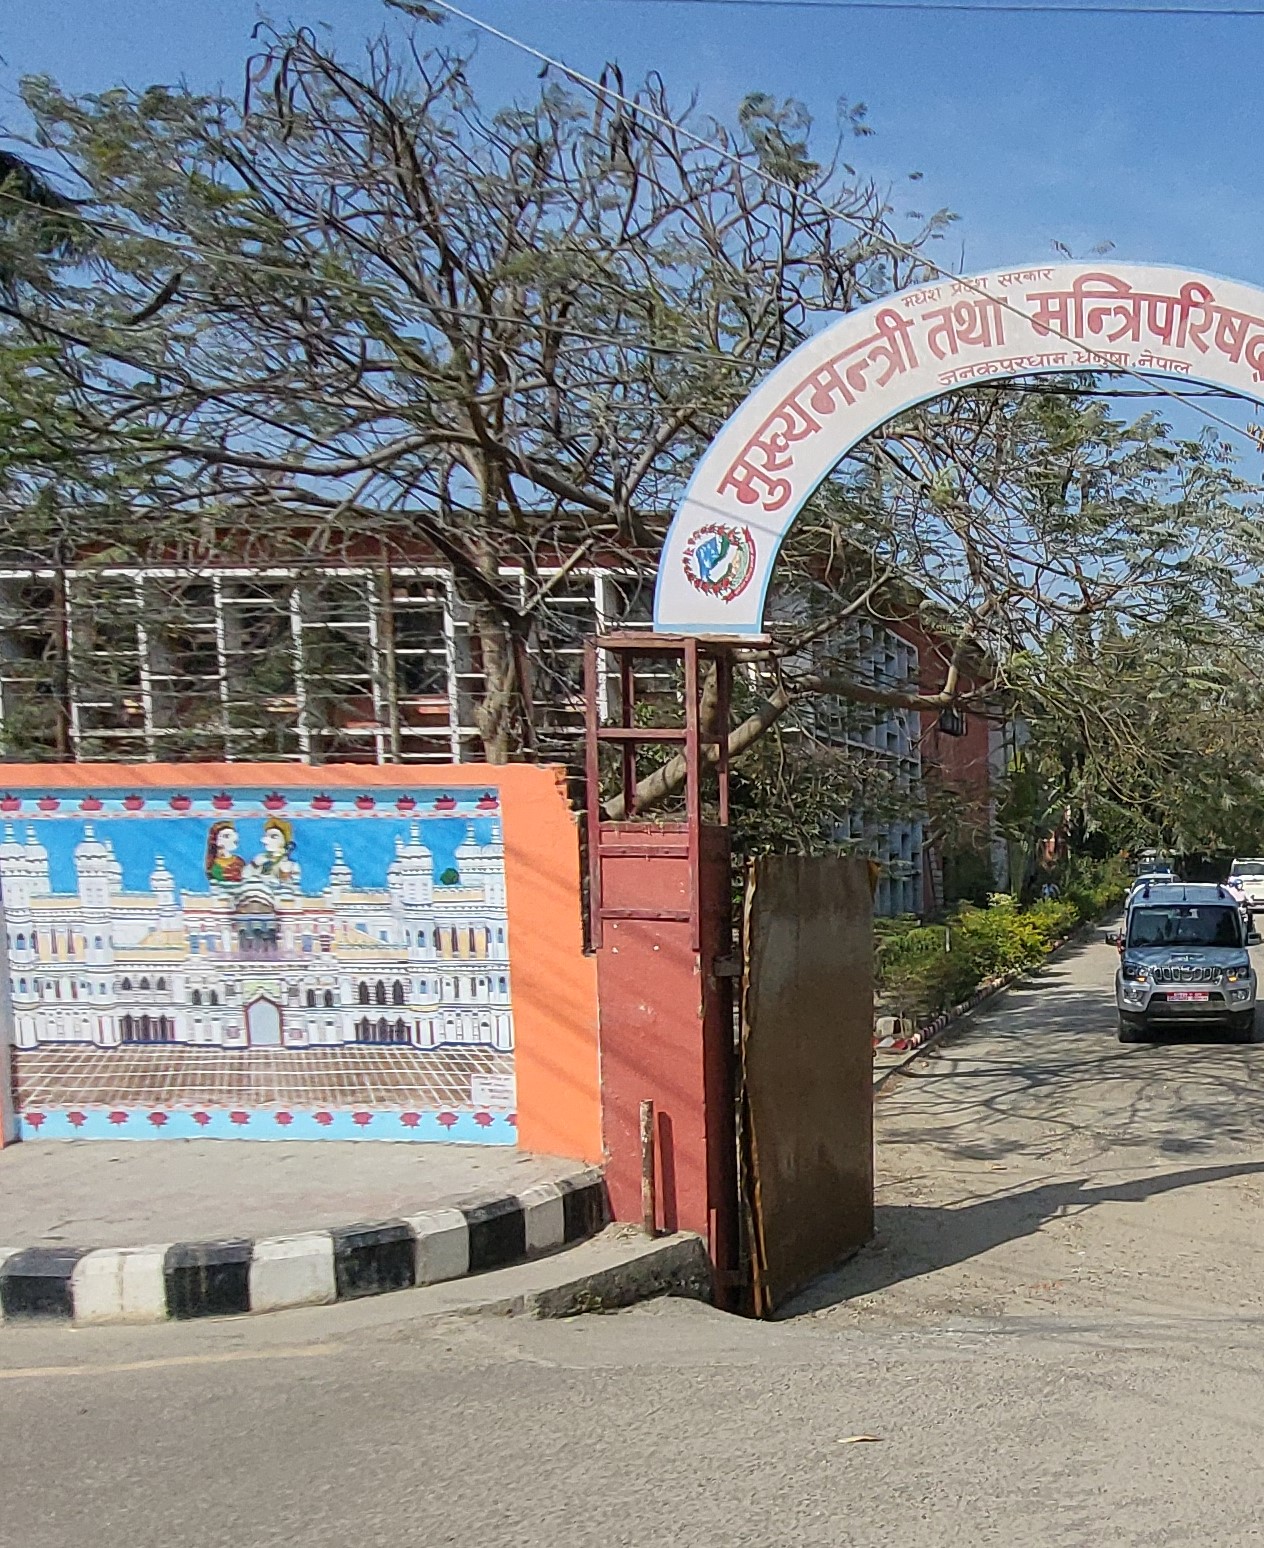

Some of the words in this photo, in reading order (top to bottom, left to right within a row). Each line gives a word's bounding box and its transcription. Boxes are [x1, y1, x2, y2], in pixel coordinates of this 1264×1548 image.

[998, 268, 1055, 287] सरकार
[1138, 349, 1193, 374] नेपाल
[716, 308, 917, 512] मुख्यमन्त्री
[922, 296, 1009, 360] तथा
